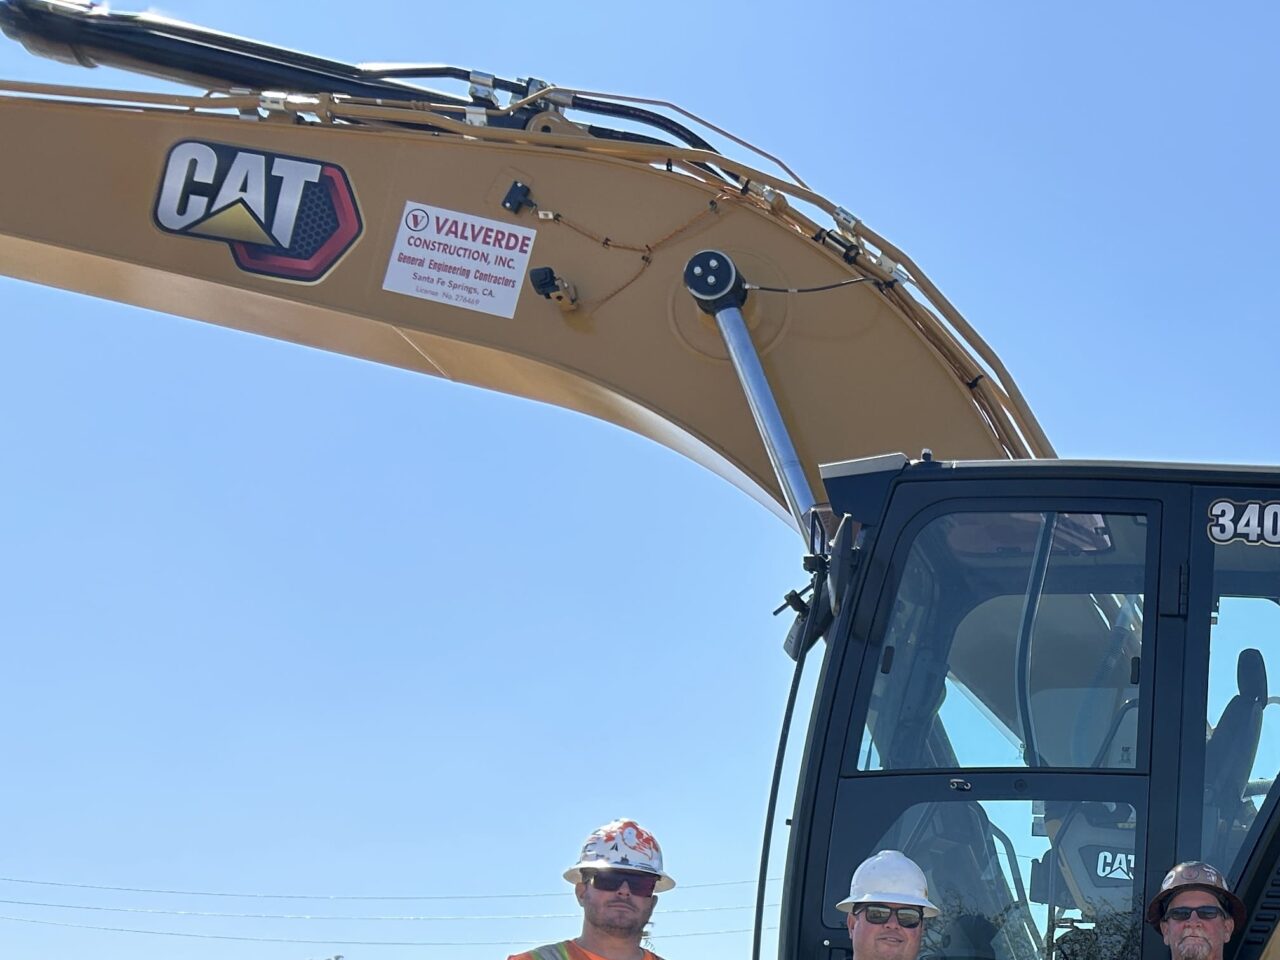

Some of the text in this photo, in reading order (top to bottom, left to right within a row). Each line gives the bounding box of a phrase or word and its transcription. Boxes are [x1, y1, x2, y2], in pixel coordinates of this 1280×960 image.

[157, 142, 322, 249] CAT
[407, 236, 516, 270] CONSTRUCTION, INC.
[434, 216, 532, 254] VALVERDE
[397, 252, 517, 288] General Engineering Contractors
[412, 273, 495, 298] Santa Fe Springs, CA.
